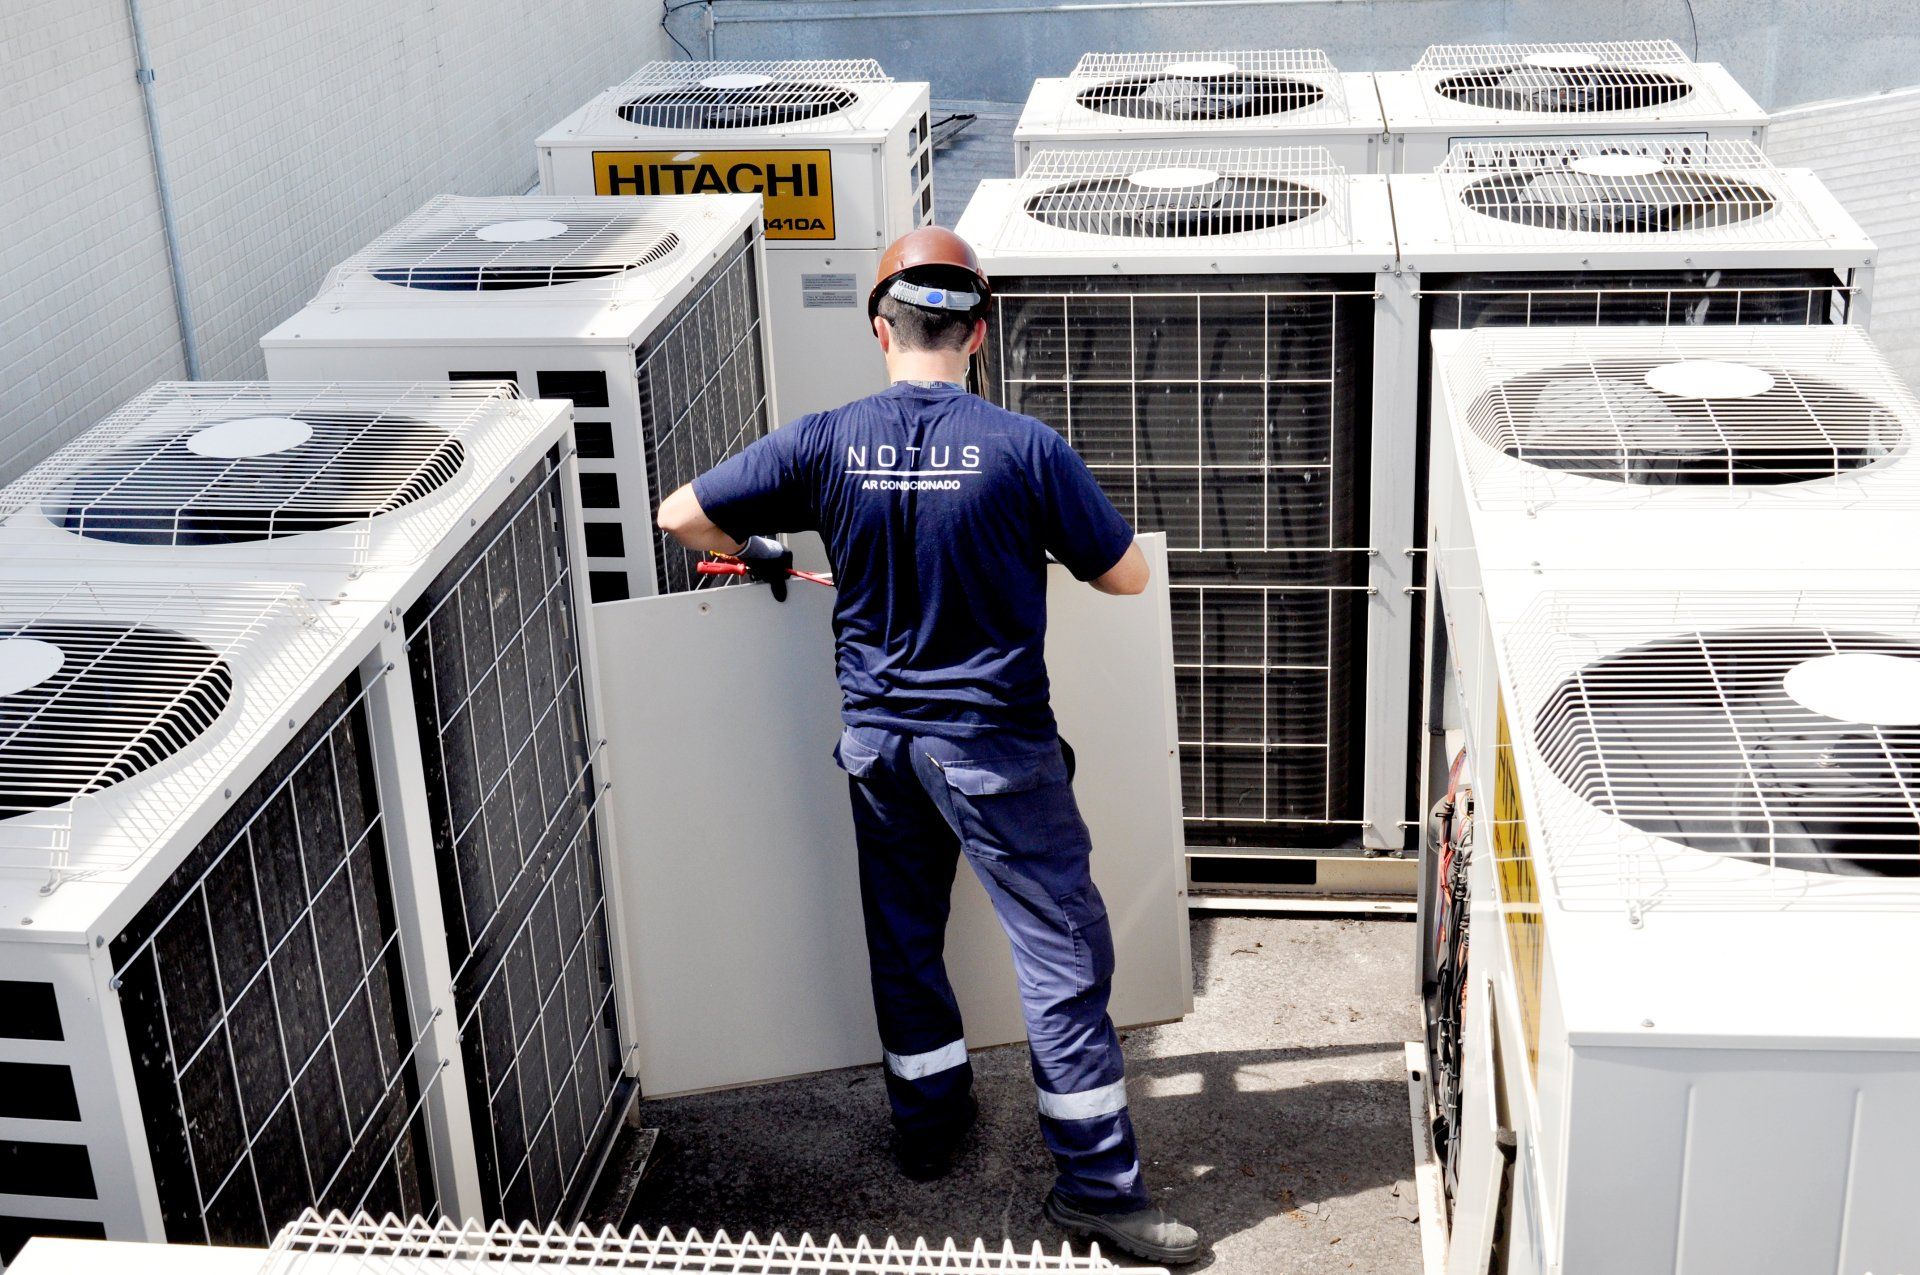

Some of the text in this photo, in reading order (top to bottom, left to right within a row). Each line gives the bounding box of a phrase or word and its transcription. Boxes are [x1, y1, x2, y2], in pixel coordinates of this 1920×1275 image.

[608, 163, 819, 197] HITACHI
[847, 445, 981, 468] NOTUS
[861, 480, 878, 491] AR
